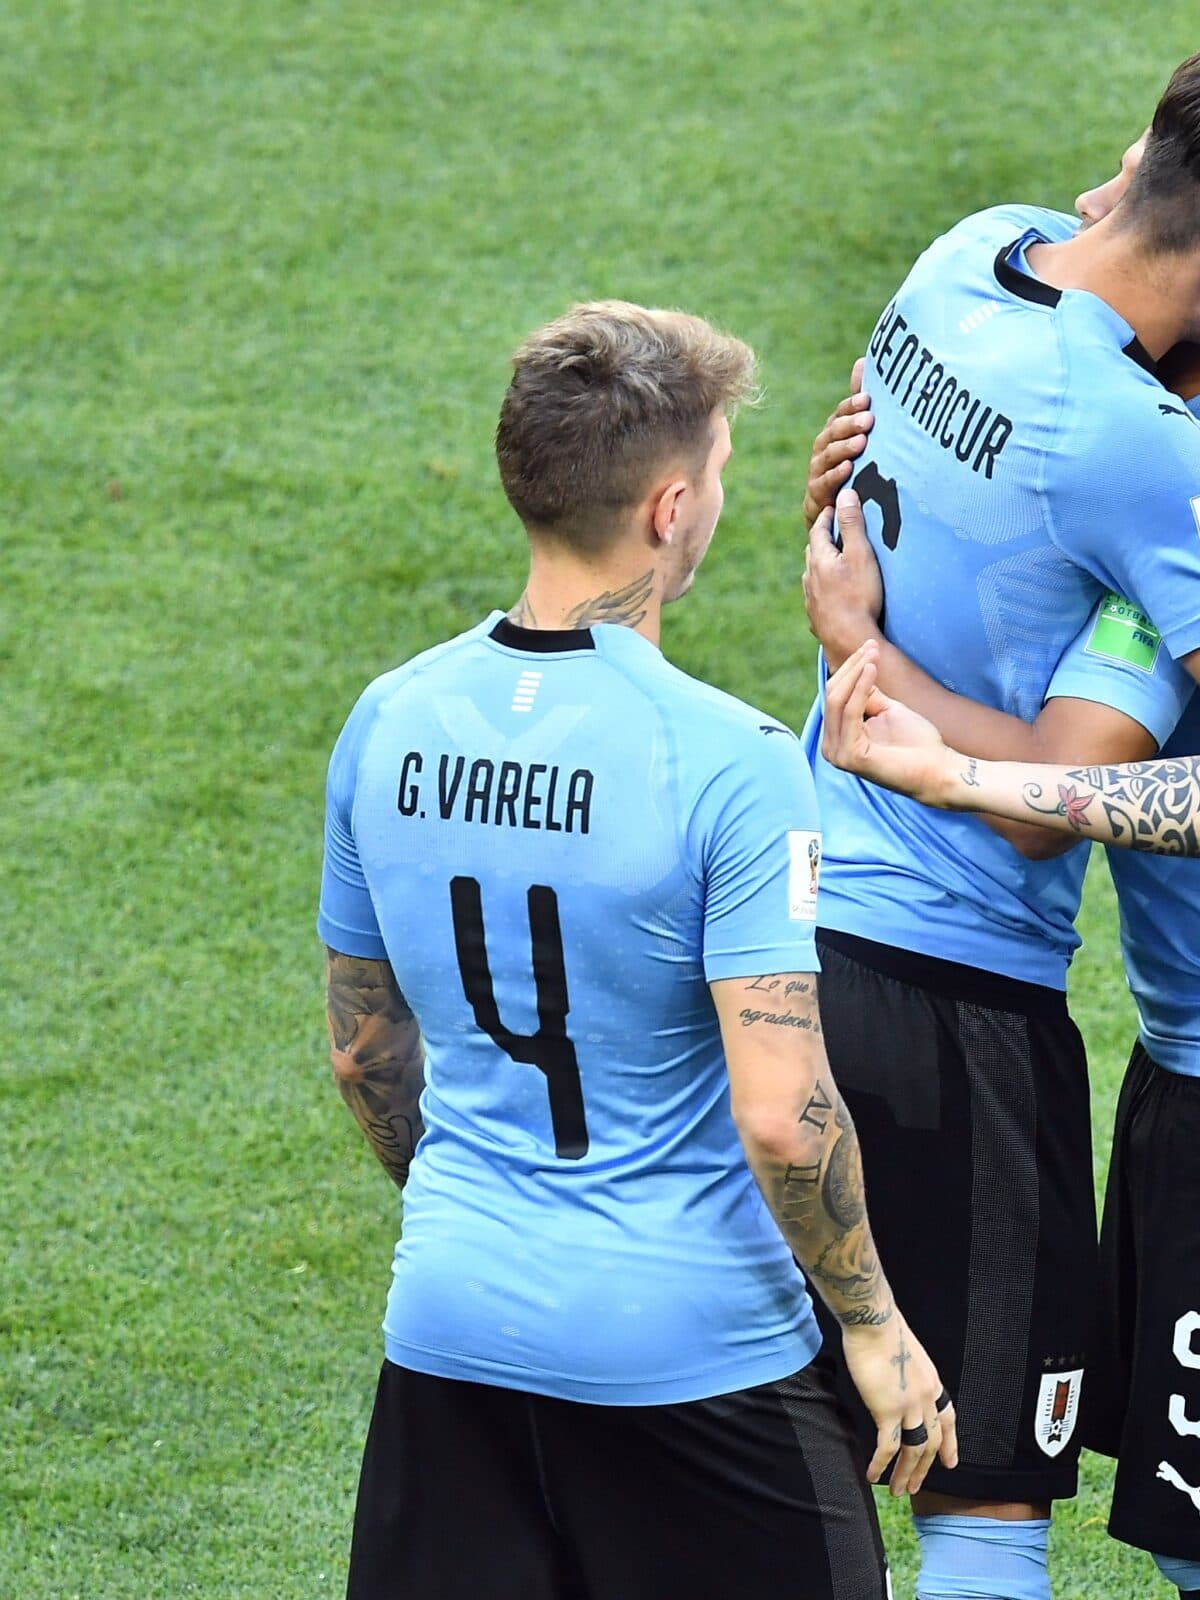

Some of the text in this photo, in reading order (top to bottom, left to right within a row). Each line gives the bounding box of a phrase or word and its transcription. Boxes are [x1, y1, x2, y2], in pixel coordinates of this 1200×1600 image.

[870, 301, 1013, 480] BENTANCUR
[1132, 631, 1154, 649] FIFA
[449, 876, 589, 1160] 4
